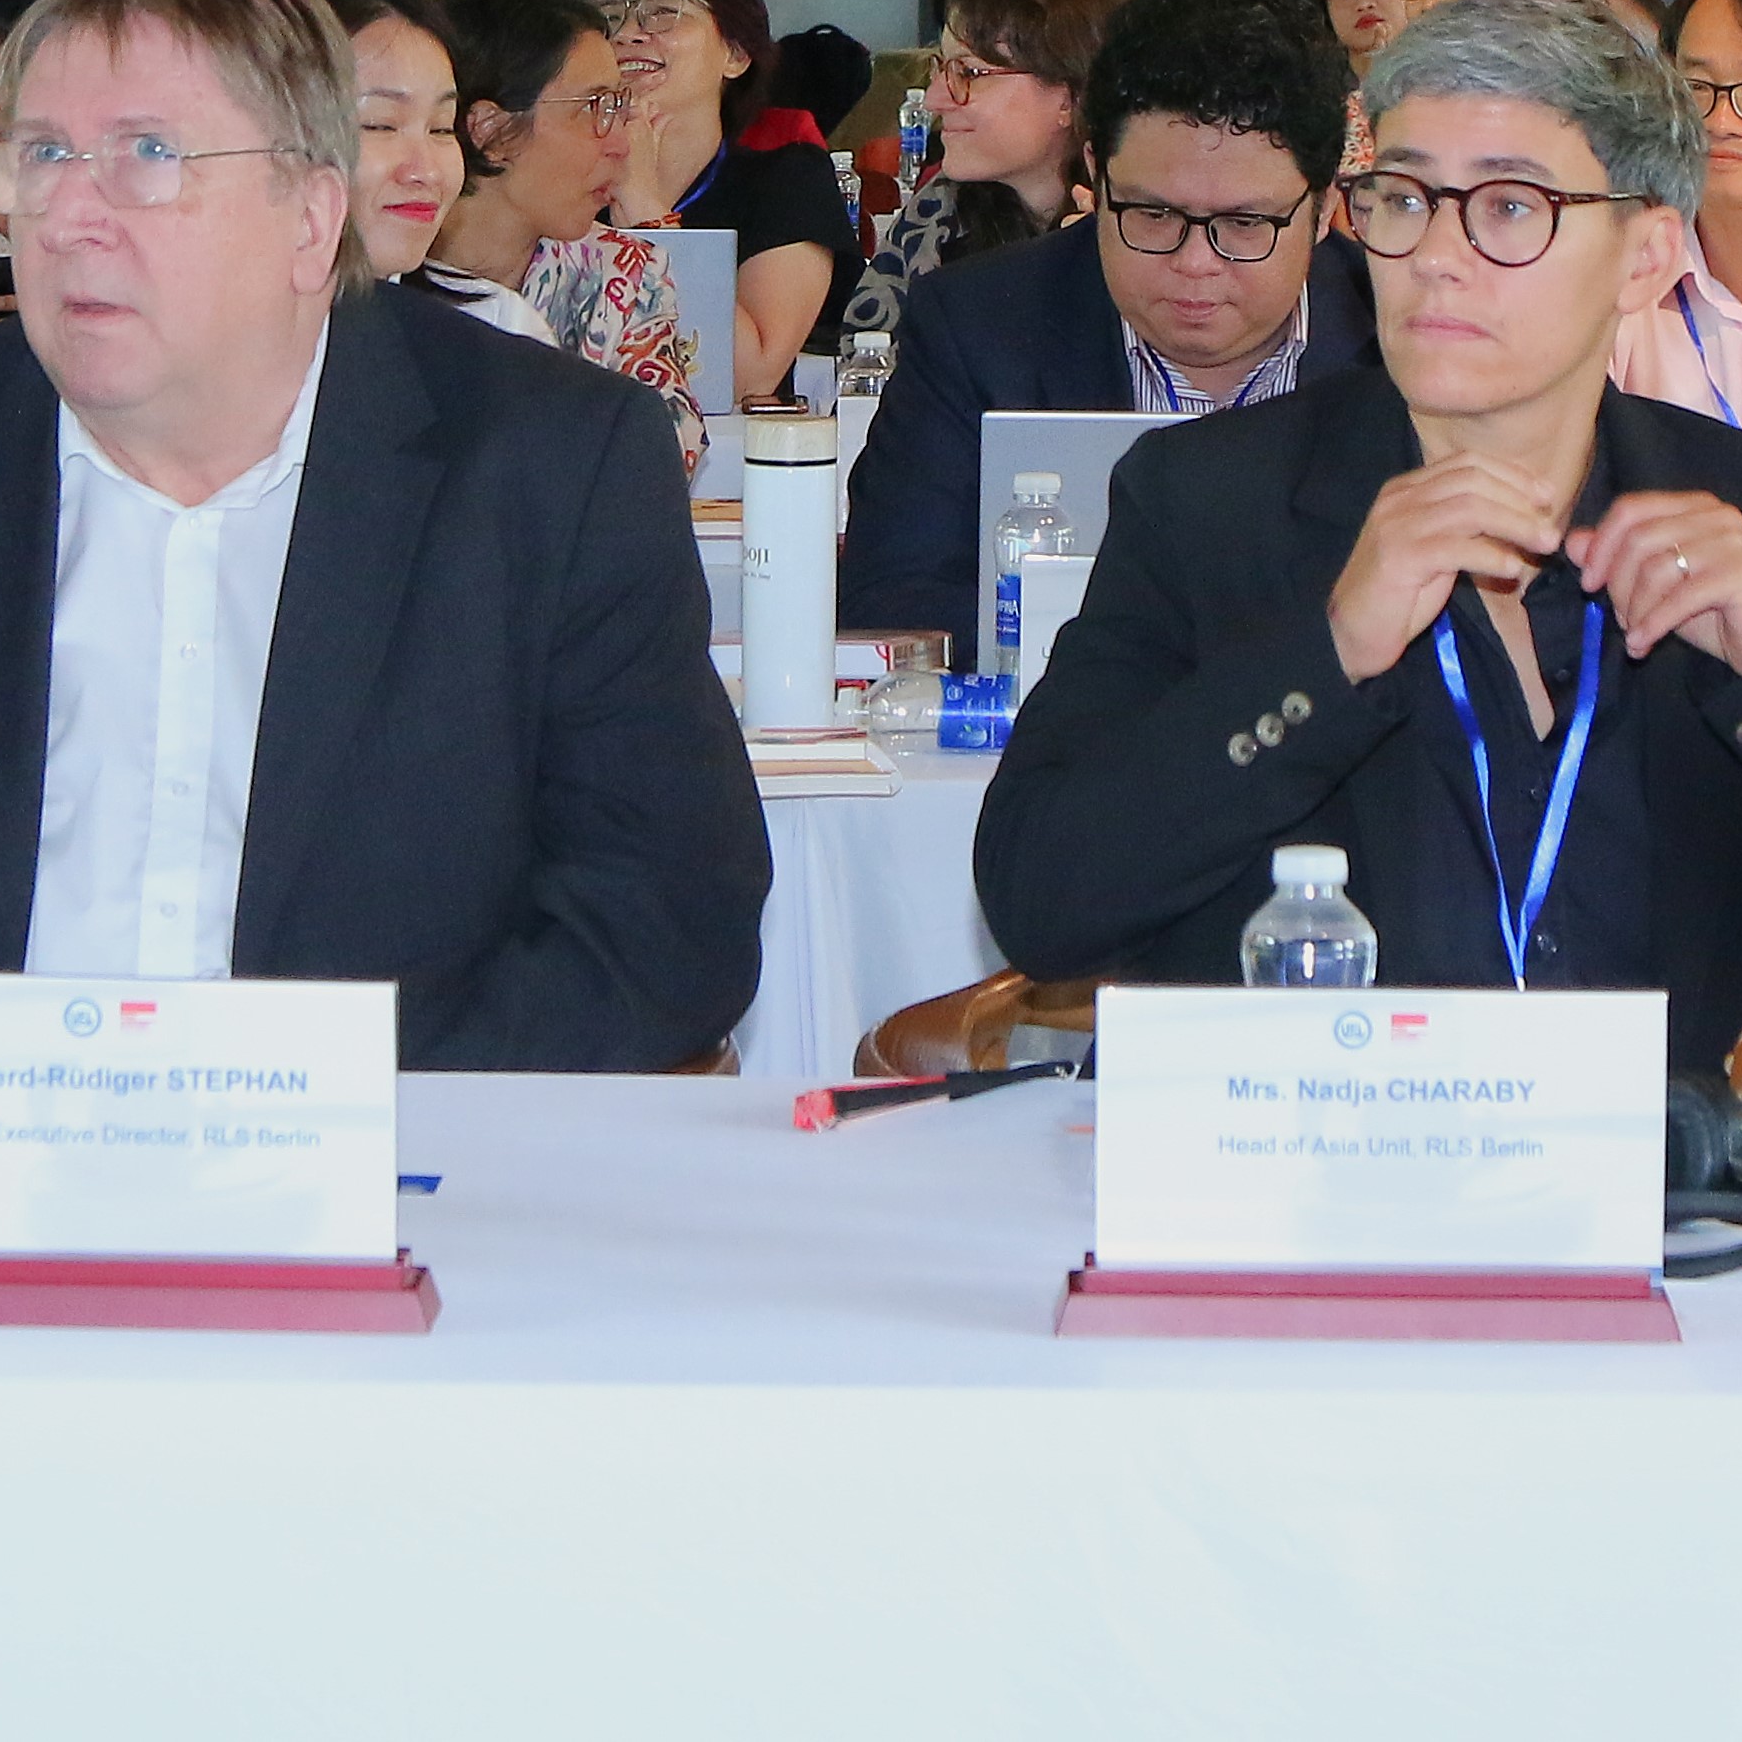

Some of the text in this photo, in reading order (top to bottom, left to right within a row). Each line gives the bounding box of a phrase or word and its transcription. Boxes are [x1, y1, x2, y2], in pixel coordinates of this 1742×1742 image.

[167, 1068, 308, 1093] STEPHAN
[1228, 1077, 1535, 1107] Mrs. Nadja CHARABY
[203, 1125, 250, 1147] RLS
[258, 1127, 320, 1148] Berlin
[1219, 1135, 1276, 1155] Head
[1284, 1136, 1305, 1155] of
[1312, 1136, 1359, 1155] Asia
[1426, 1137, 1473, 1157] RLS
[1481, 1137, 1543, 1157] Berlin
